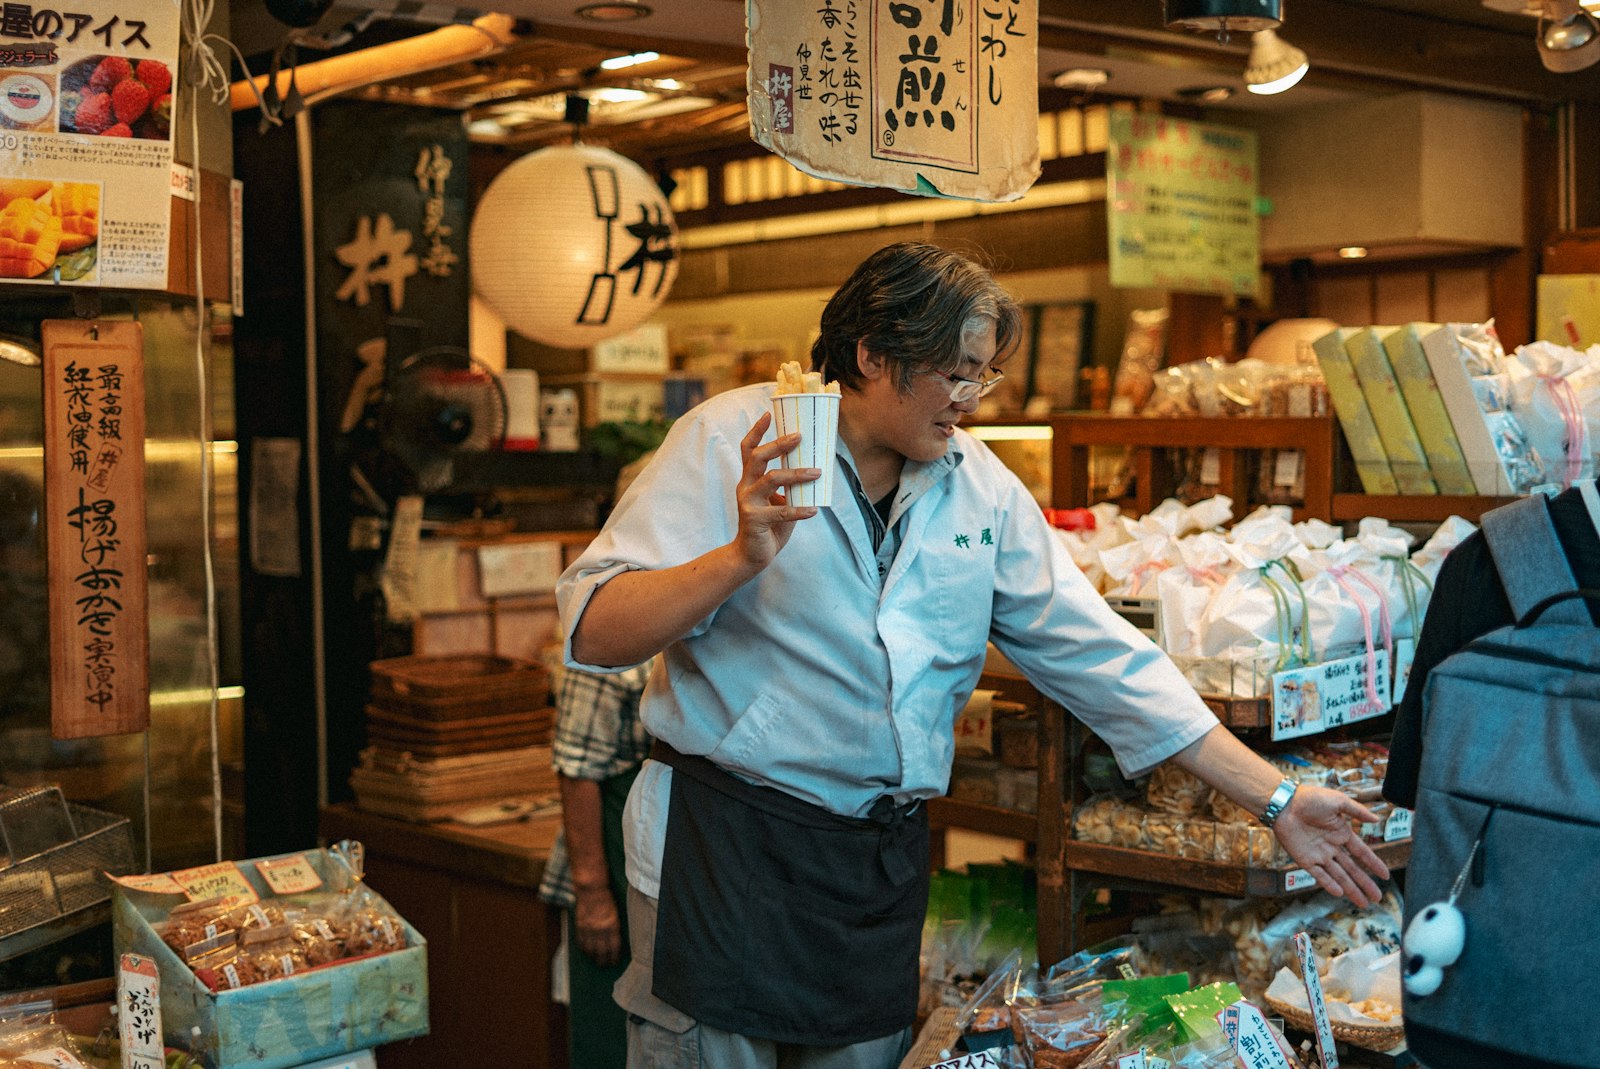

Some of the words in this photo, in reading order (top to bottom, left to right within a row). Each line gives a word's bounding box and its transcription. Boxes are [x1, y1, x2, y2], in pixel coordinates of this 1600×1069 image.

[0, 2, 151, 49] 屋のアイス
[1005, 0, 1027, 36] と
[770, 69, 793, 129] 杵屋
[795, 43, 812, 99] 仲見世
[64, 360, 95, 475] 紅花油使用
[96, 364, 124, 440] 最高級
[67, 487, 124, 712] 揚げおかき実演中
